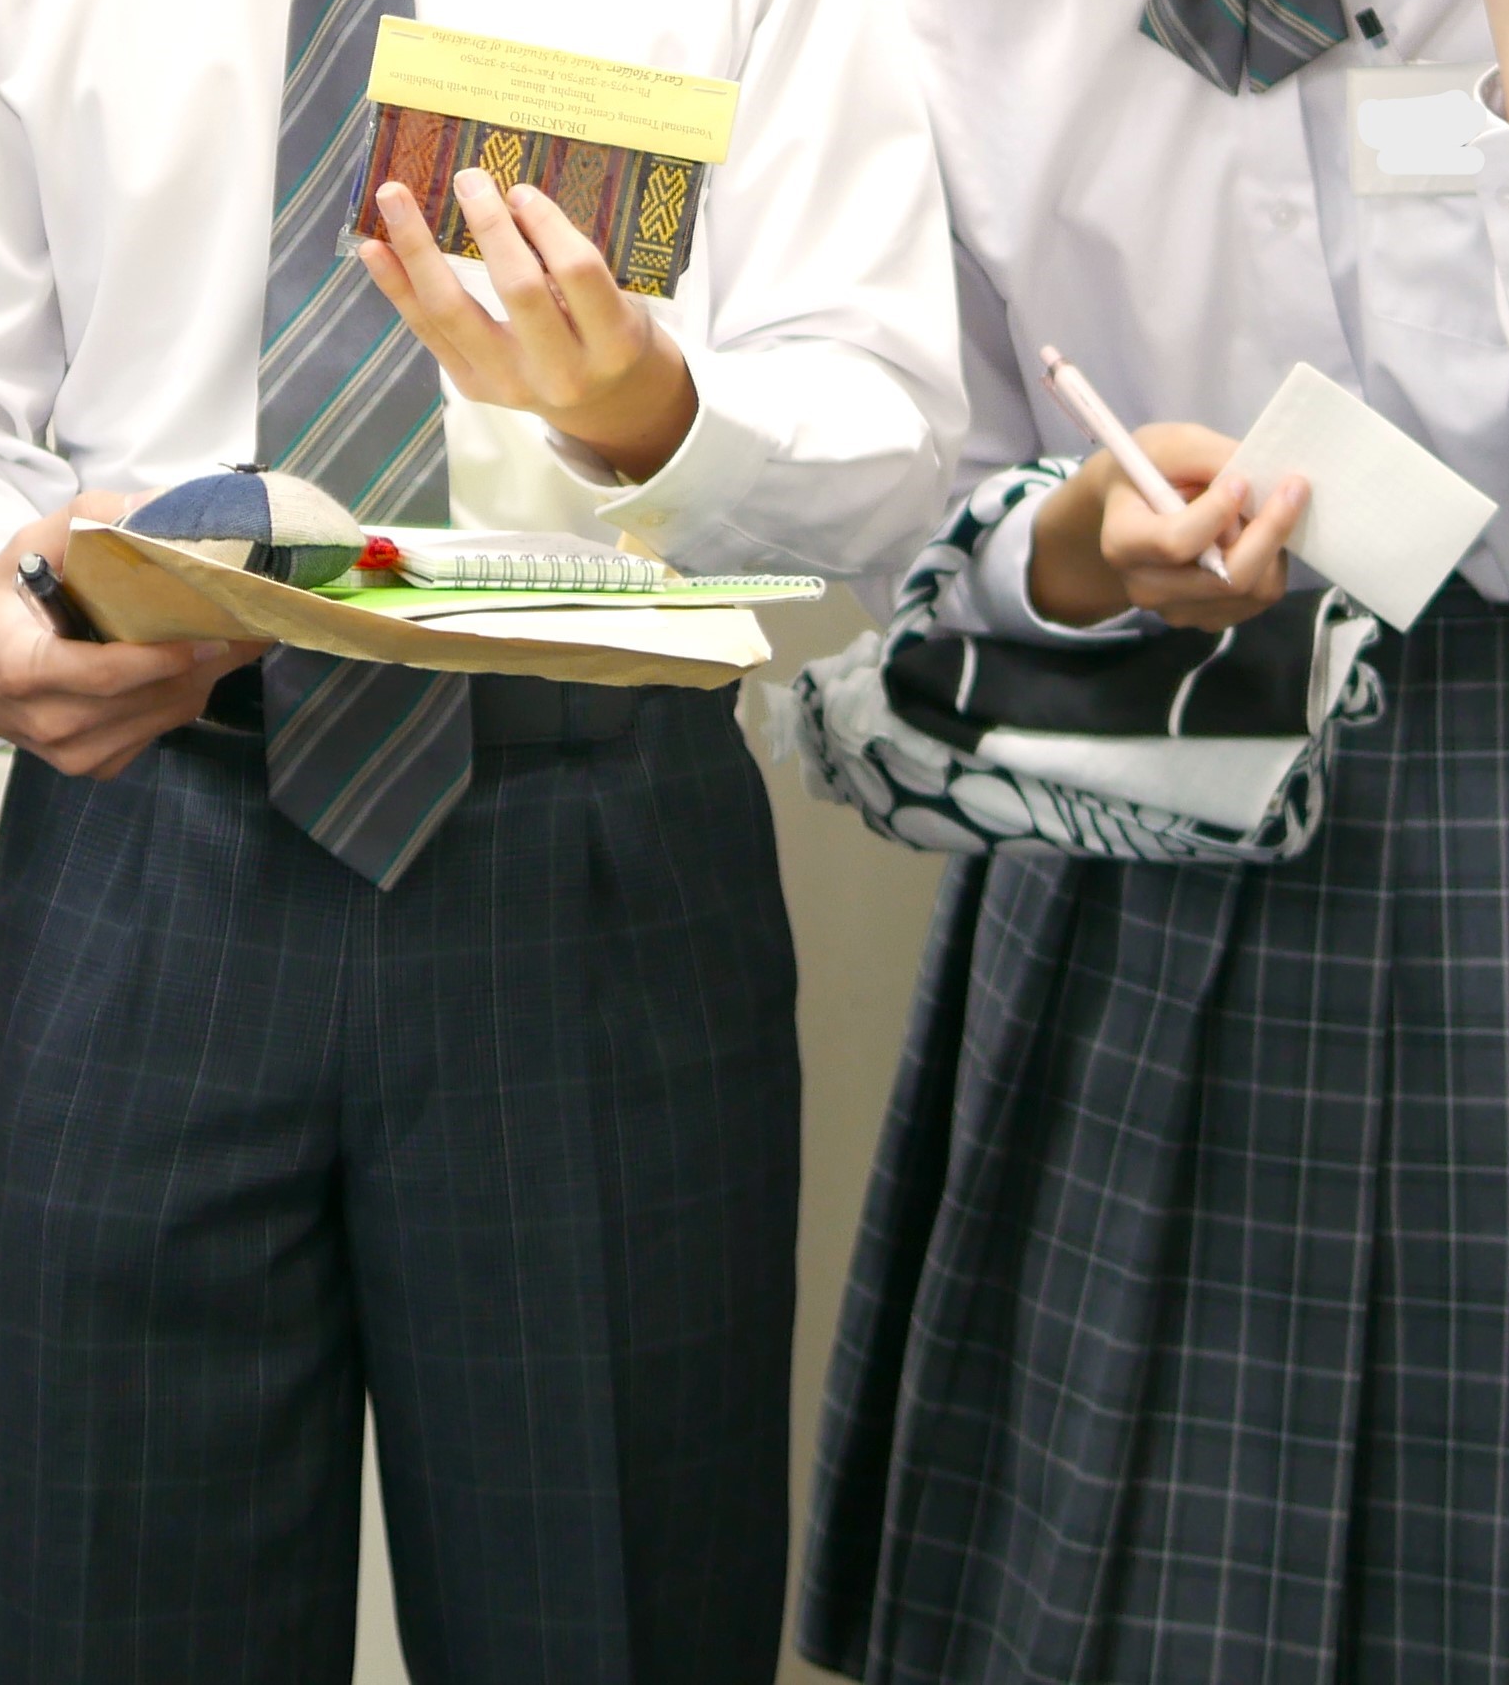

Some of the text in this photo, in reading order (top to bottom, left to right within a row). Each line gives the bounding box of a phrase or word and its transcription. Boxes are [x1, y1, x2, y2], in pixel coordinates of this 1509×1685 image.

[431, 30, 683, 87] Card Holder Made by Student of Draktsho
[388, 70, 713, 139] Vocational Training Center for Children and Youth with Disabilities
[509, 78, 545, 94] Bhutan
[509, 110, 586, 135] DRAKTSHO
